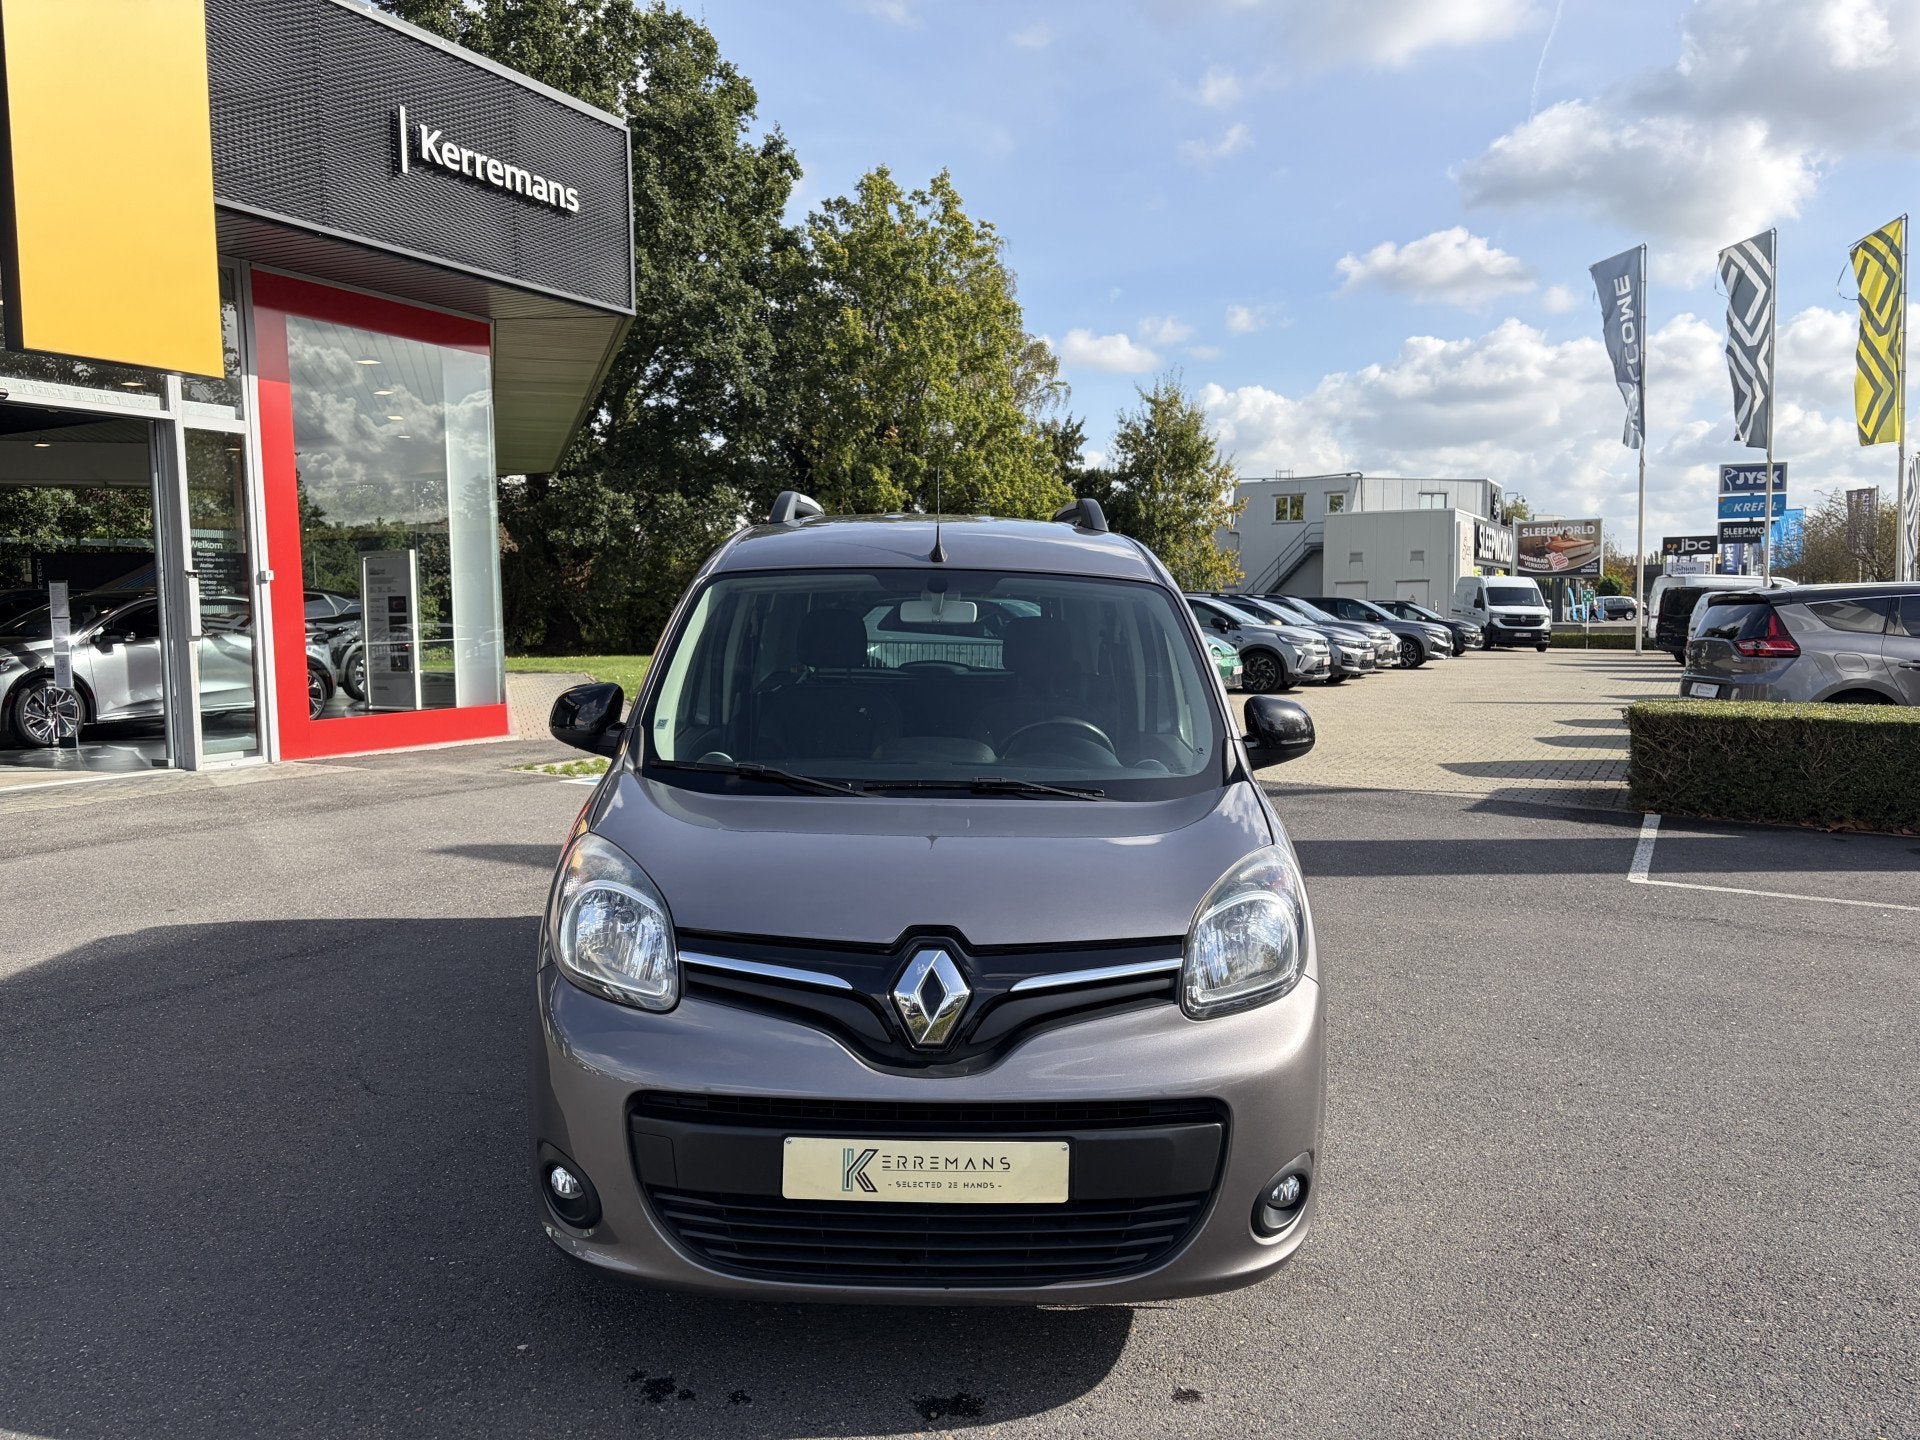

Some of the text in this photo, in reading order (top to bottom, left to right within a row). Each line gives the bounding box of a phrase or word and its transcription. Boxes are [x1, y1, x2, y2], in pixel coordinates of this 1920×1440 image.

[420, 123, 580, 213] Kerremans
[1735, 470, 1781, 485] JYSK
[1733, 501, 1777, 512] KREFL
[1522, 525, 1596, 537] SLEEPWORLD
[191, 540, 223, 550] Welkom
[1478, 524, 1513, 563] SLEEPWORLD
[1678, 538, 1711, 553] jbc
[1519, 553, 1549, 563] VOORRAAD
[1524, 560, 1550, 570] VERKOOP
